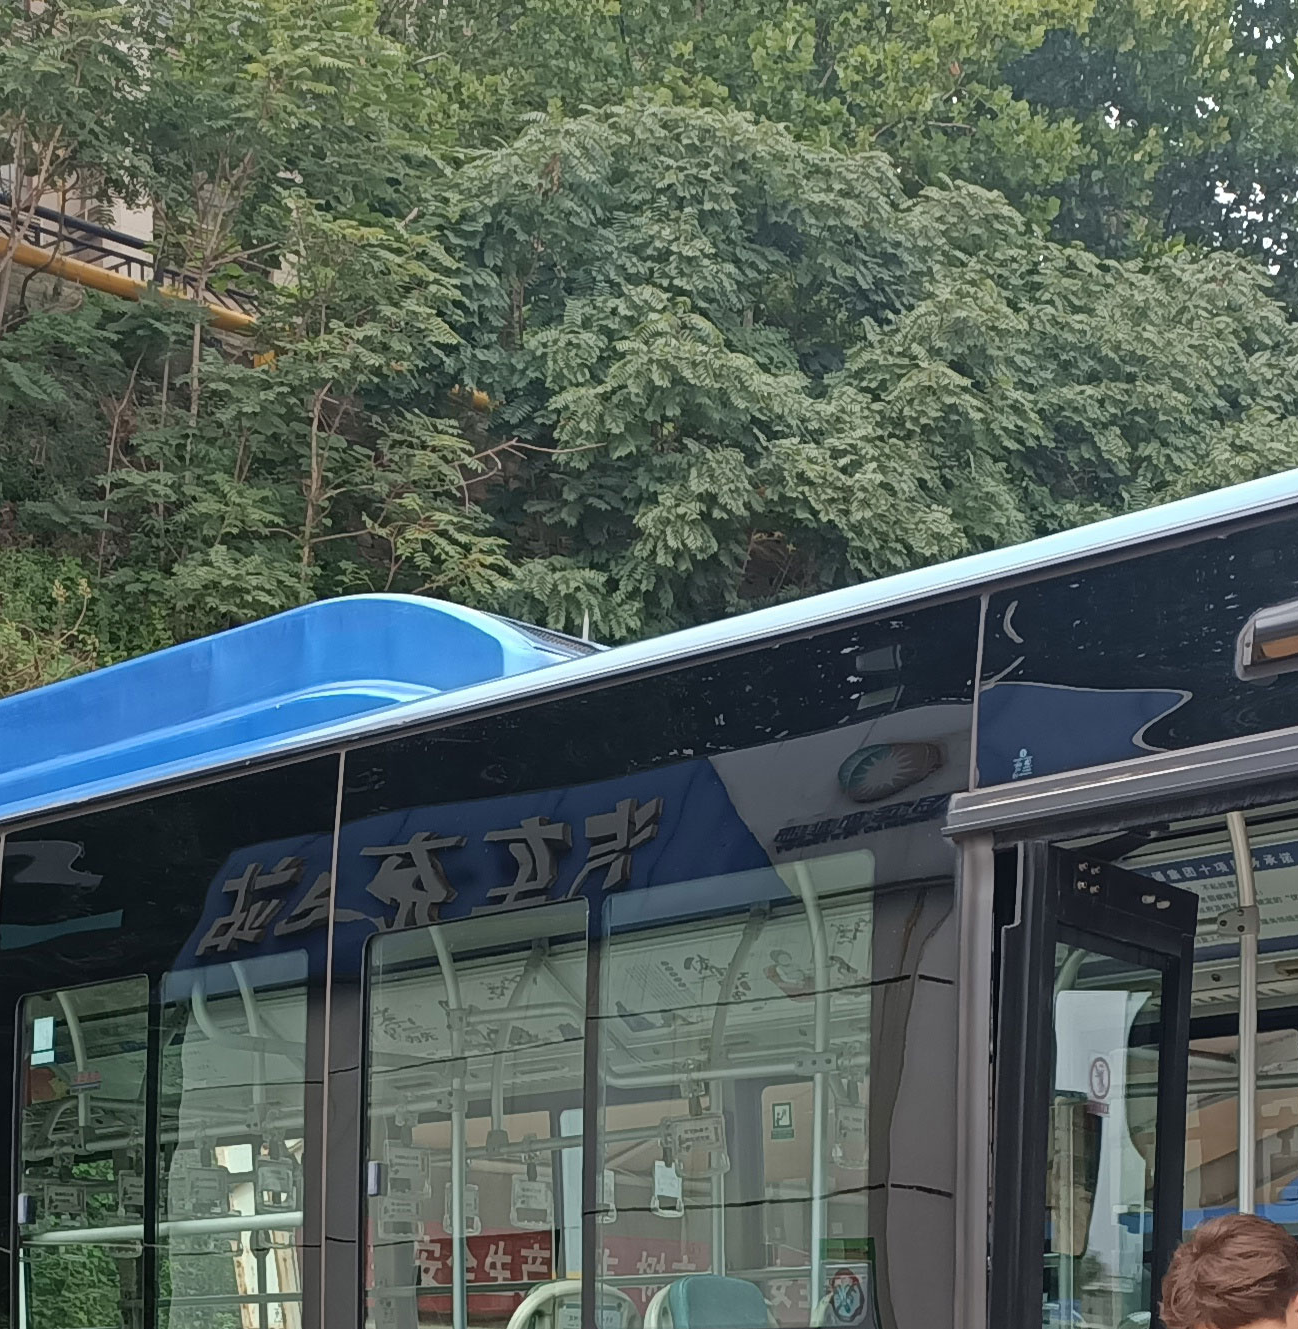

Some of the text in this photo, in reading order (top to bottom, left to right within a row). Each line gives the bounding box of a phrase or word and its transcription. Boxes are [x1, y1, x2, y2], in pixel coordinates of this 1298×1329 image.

[1151, 851, 1295, 882] 集团十项承诺
